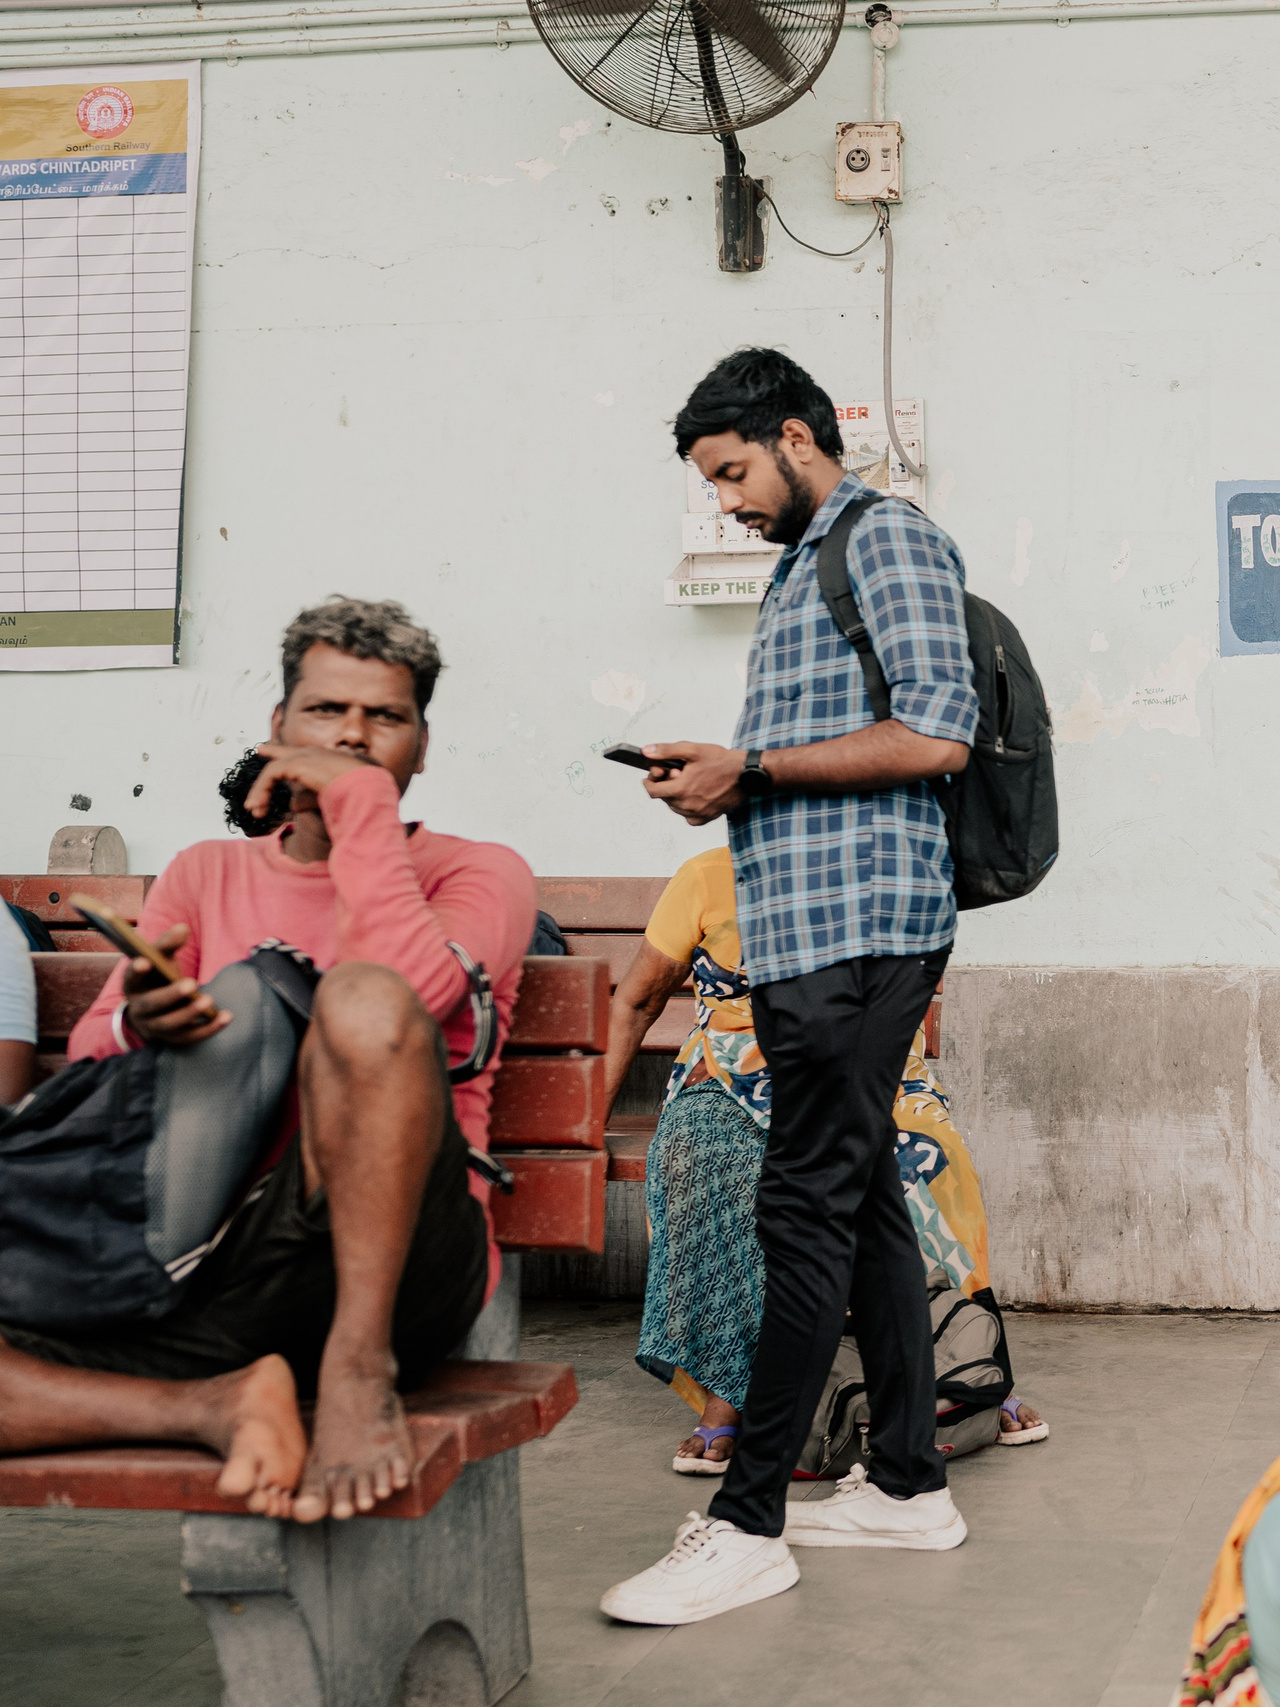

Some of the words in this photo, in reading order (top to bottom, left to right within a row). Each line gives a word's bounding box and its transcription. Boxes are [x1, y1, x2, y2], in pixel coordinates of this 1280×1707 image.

[102, 87, 125, 98] INDIAN
[123, 95, 133, 127] RAILWAYS
[65, 143, 111, 152] Southern
[113, 141, 151, 151] Railway
[0, 162, 37, 176] ARDS
[40, 159, 137, 174] CHINTADRIPET
[679, 583, 720, 597] KEEP
[725, 581, 757, 595] THE
